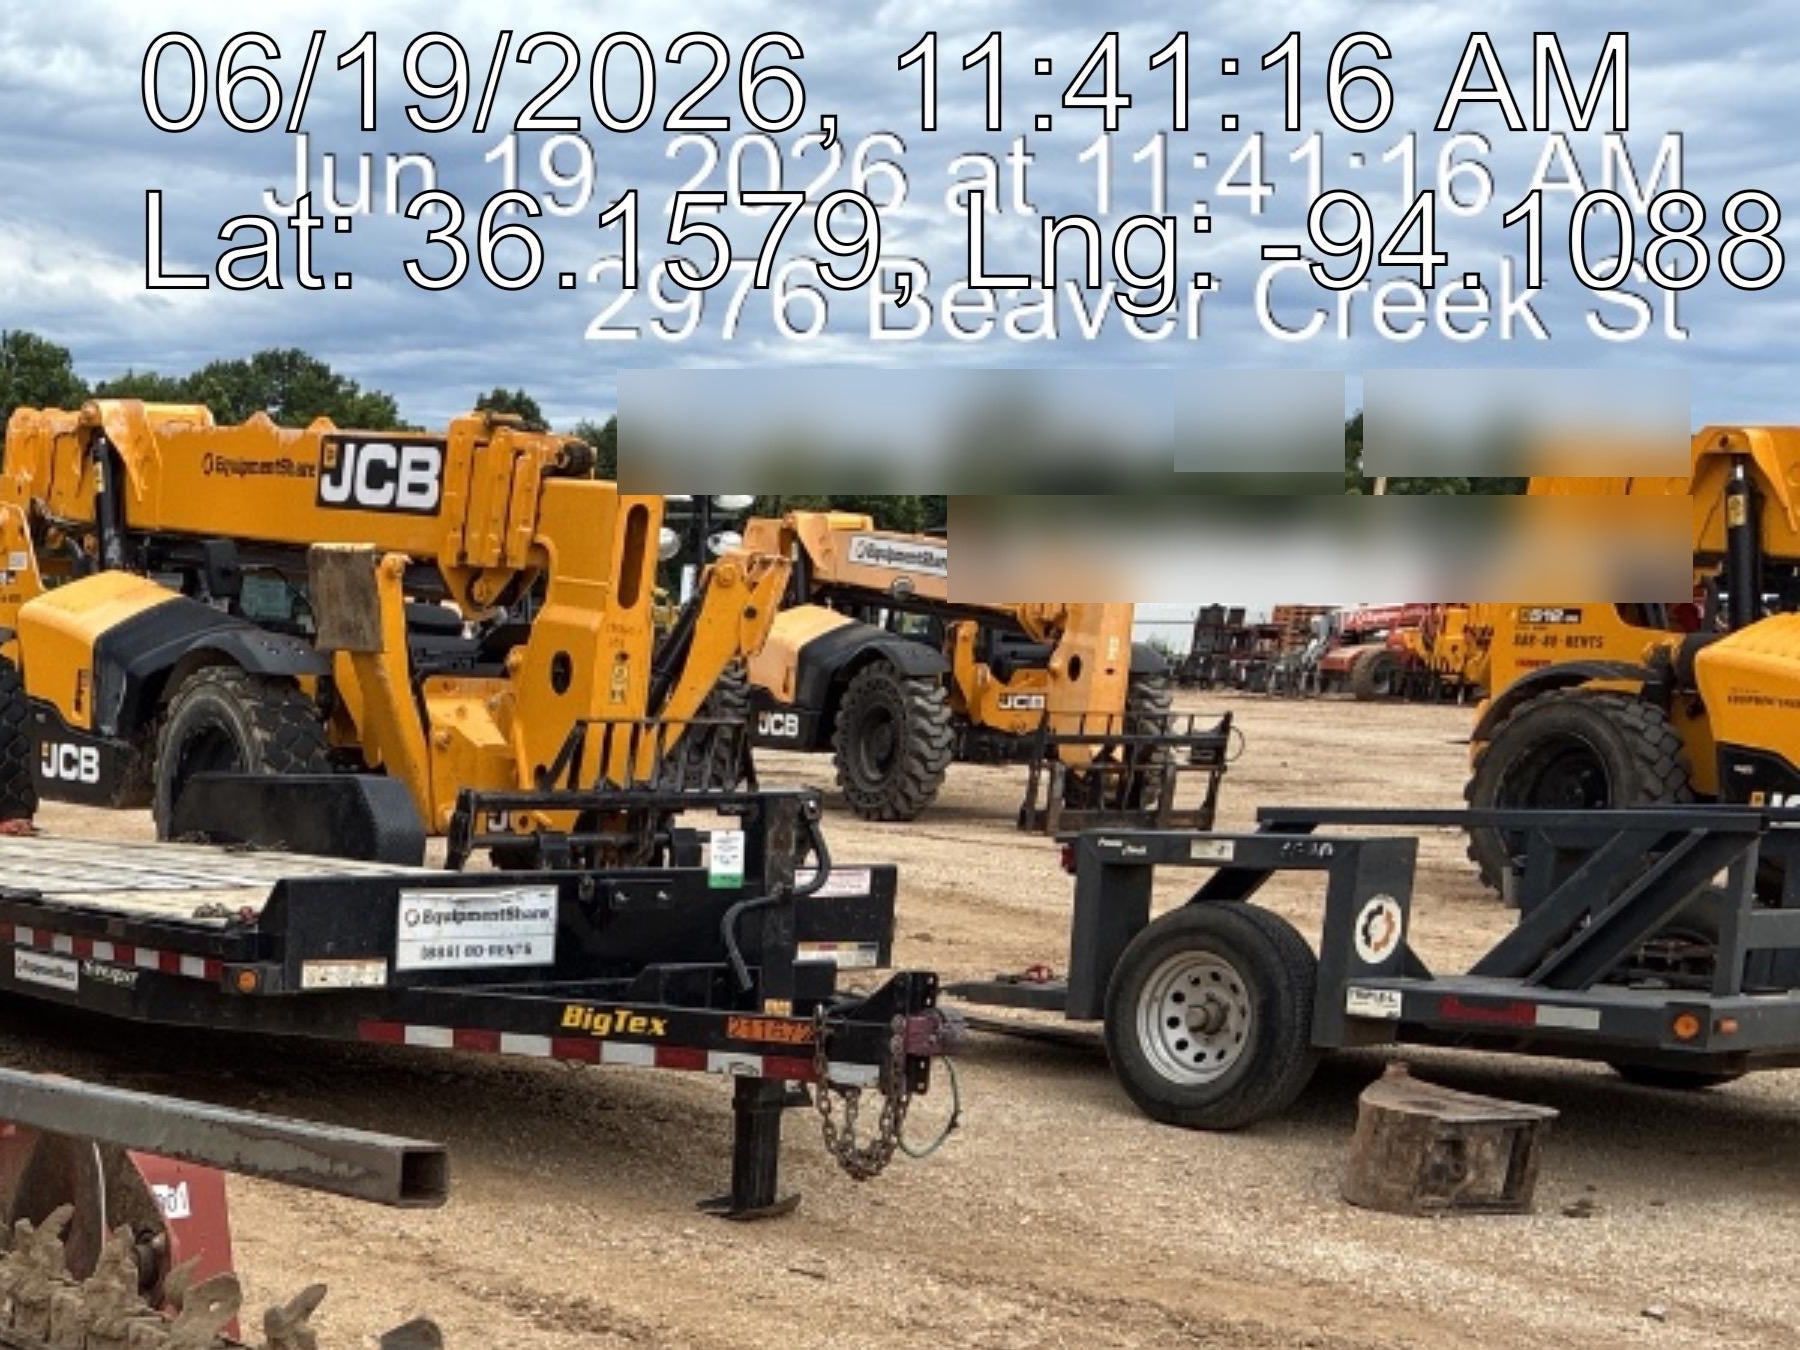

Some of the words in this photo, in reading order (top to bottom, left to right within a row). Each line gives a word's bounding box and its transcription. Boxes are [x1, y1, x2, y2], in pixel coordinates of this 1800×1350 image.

[319, 442, 442, 509] JCB
[757, 711, 800, 739] JCB
[41, 742, 100, 784] JCB
